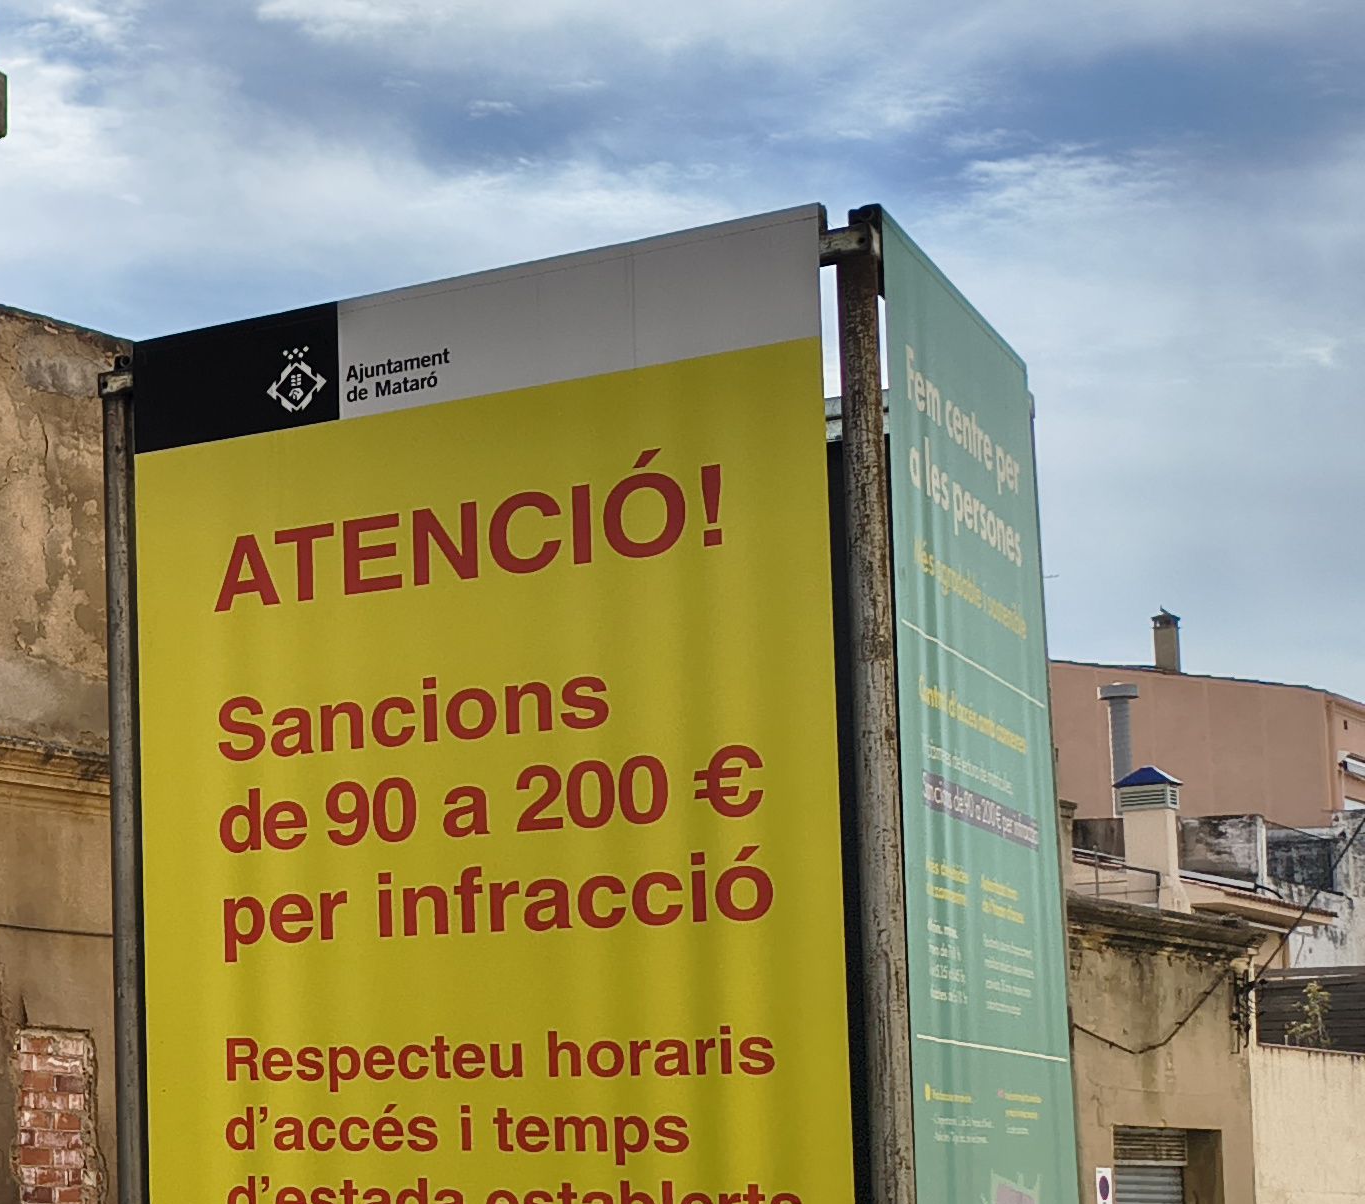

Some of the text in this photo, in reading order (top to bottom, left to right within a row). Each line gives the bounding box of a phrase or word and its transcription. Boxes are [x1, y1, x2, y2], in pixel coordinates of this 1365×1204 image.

[346, 348, 450, 383] Ajuntament
[347, 371, 437, 403] de Mataró
[905, 343, 1020, 496] Fem centre per
[214, 447, 723, 614] ATENCIÓ!
[909, 436, 1022, 568] a les persones
[218, 675, 609, 762] Sancions
[218, 744, 764, 853] de 90 a 200 €
[222, 845, 774, 963] per infracció
[226, 1025, 776, 1092] Respecteu horaris
[225, 1102, 690, 1165] d’accés i temps
